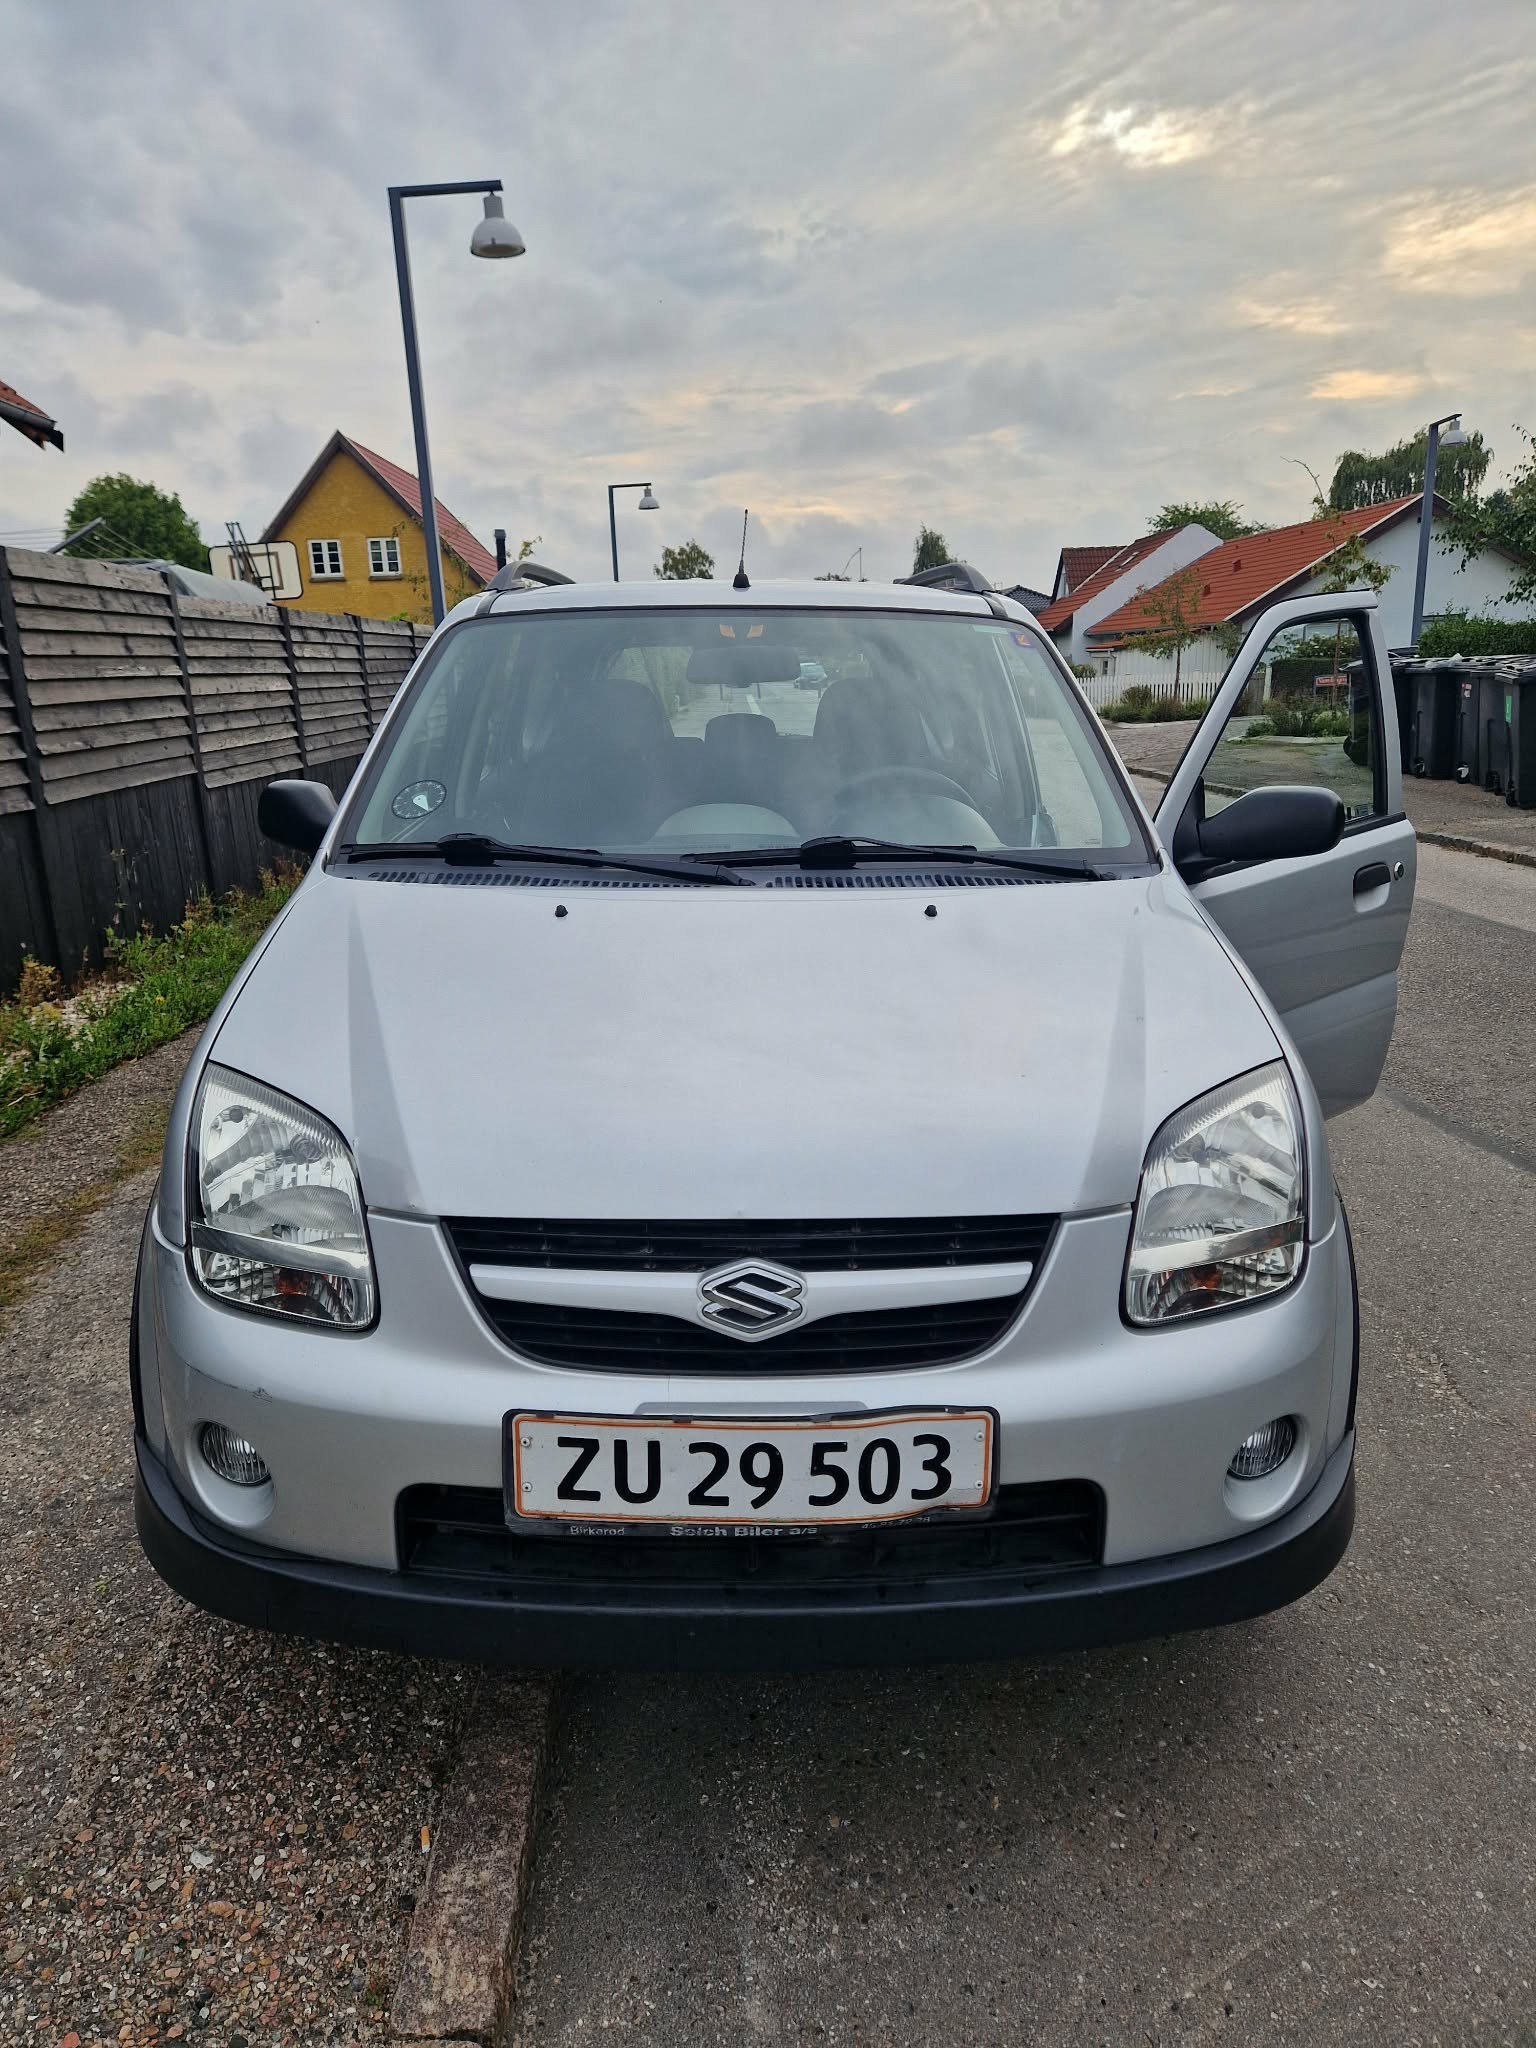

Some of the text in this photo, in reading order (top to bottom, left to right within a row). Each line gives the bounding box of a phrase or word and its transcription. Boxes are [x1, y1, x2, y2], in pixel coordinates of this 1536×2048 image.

[557, 1433, 952, 1509] ZU 29 503
